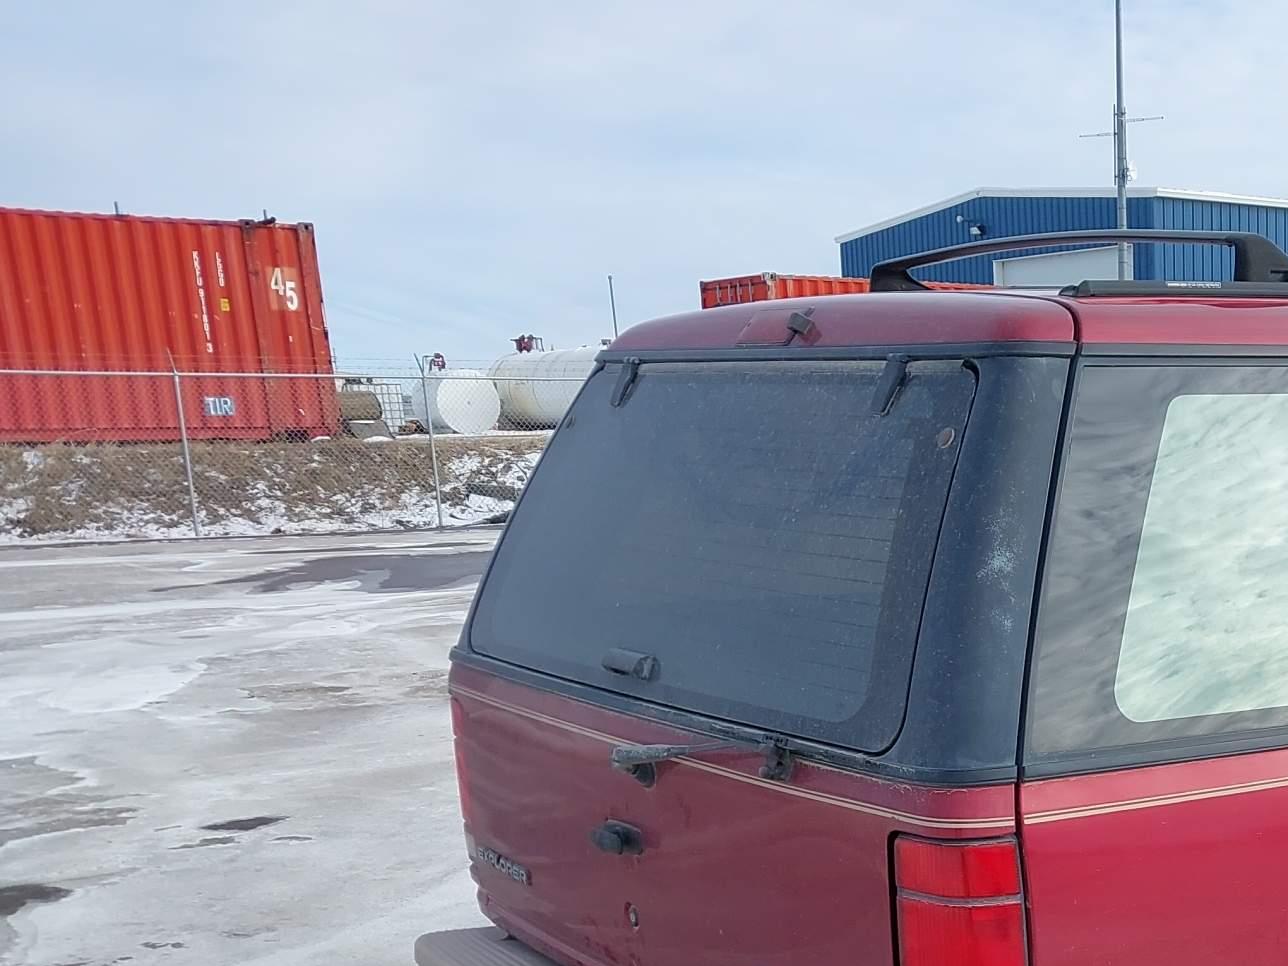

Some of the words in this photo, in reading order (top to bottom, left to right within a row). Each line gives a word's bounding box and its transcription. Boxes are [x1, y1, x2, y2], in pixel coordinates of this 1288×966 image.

[271, 267, 298, 311] 45
[205, 397, 234, 415] TIR
[478, 847, 527, 886] EXPLORER
